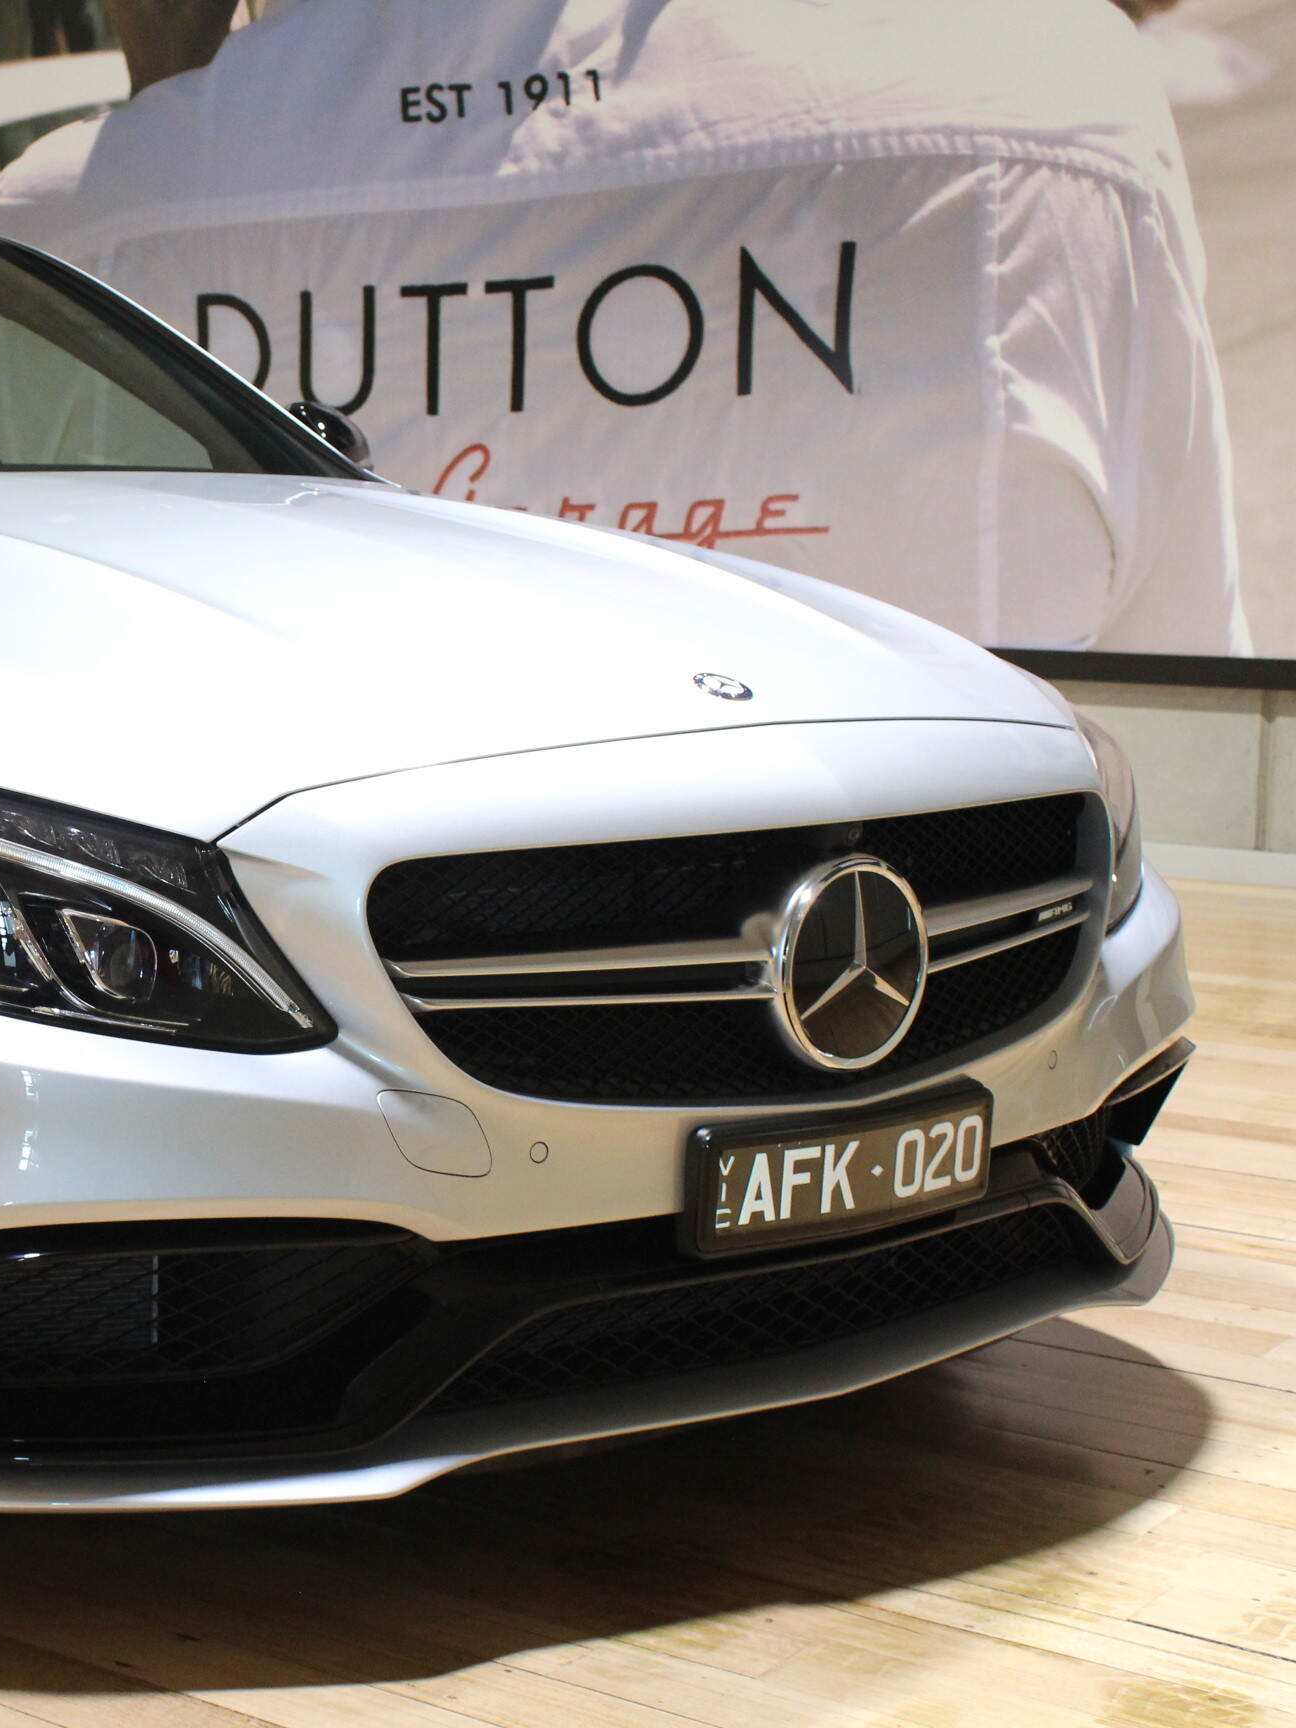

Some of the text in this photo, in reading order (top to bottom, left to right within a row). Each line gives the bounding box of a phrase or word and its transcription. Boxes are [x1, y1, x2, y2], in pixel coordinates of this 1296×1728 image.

[400, 69, 601, 124] EST 1911
[197, 240, 857, 416] DUTTON
[715, 1155, 736, 1229] VIC
[738, 1114, 984, 1226] AFK 020
